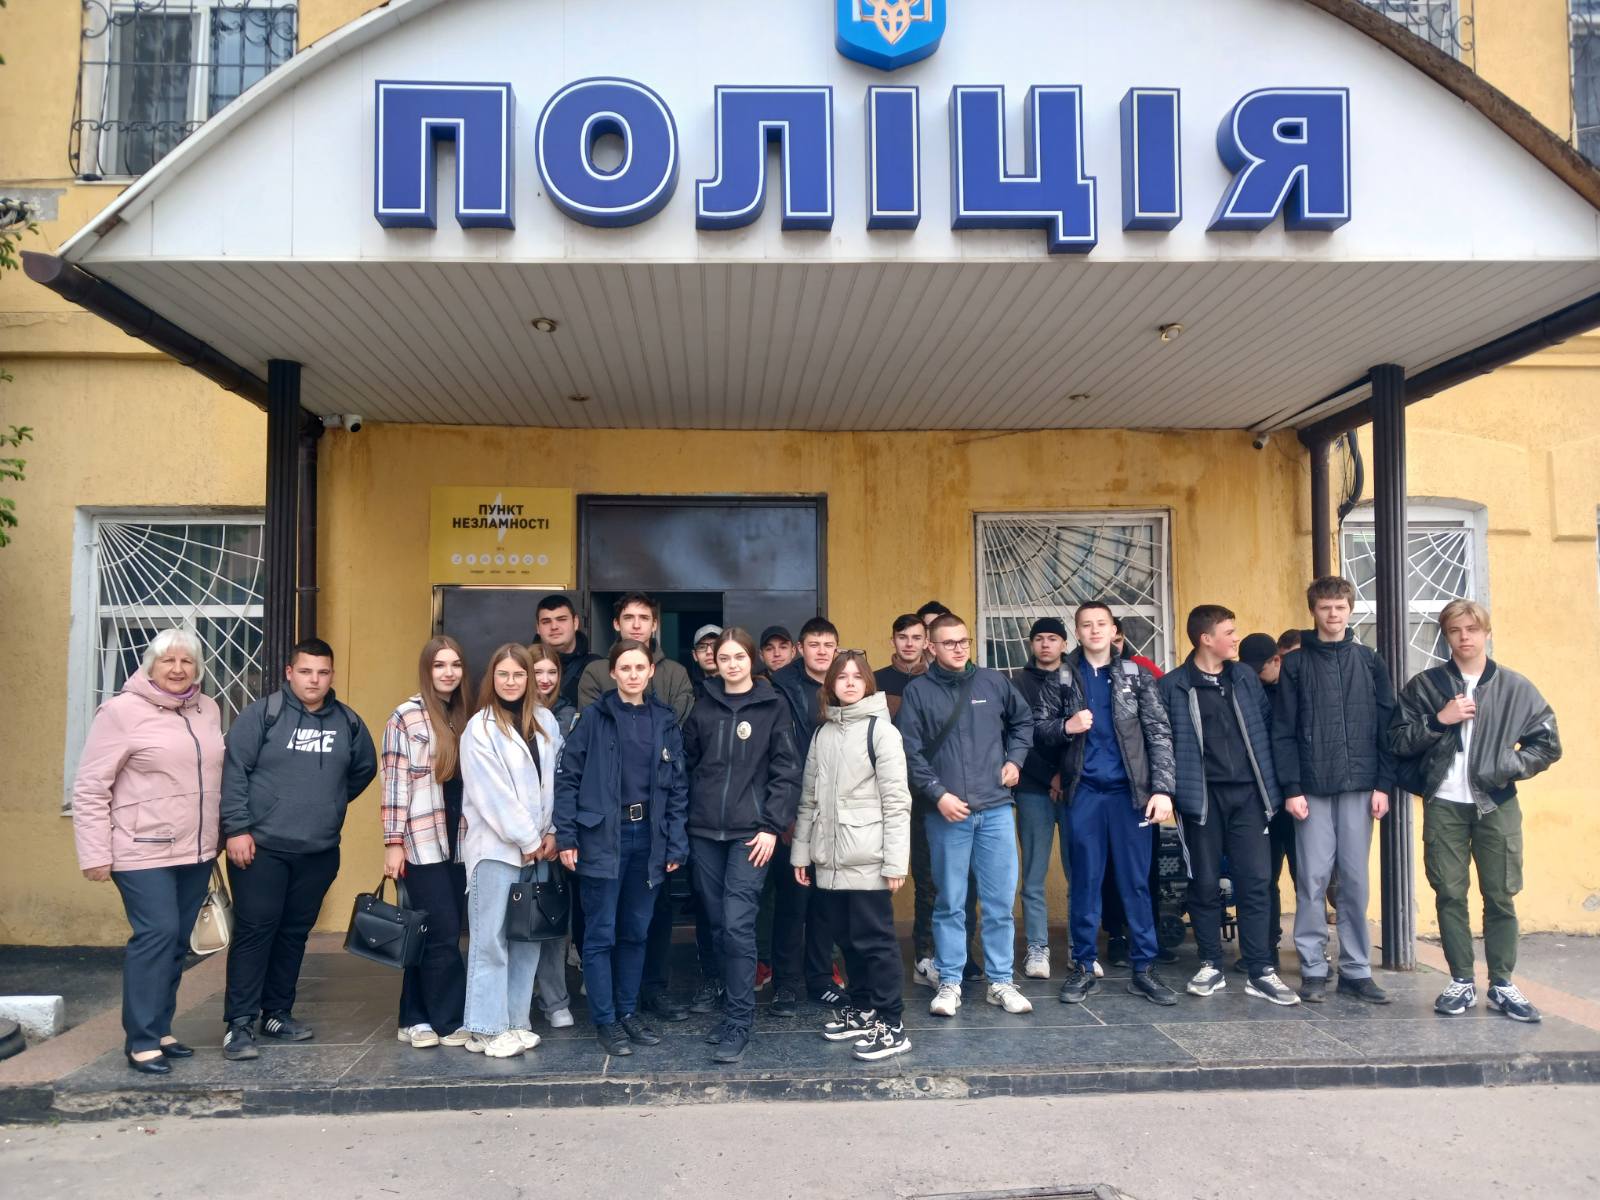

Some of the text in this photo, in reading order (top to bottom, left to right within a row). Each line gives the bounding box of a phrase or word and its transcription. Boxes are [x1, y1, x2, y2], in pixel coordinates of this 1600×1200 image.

[374, 76, 1352, 254] ПОЛІЦІЯ
[478, 504, 524, 515] ПУНКТ
[452, 517, 549, 529] НЕЗЛАМНОСТІ
[286, 727, 337, 752] NIKE
